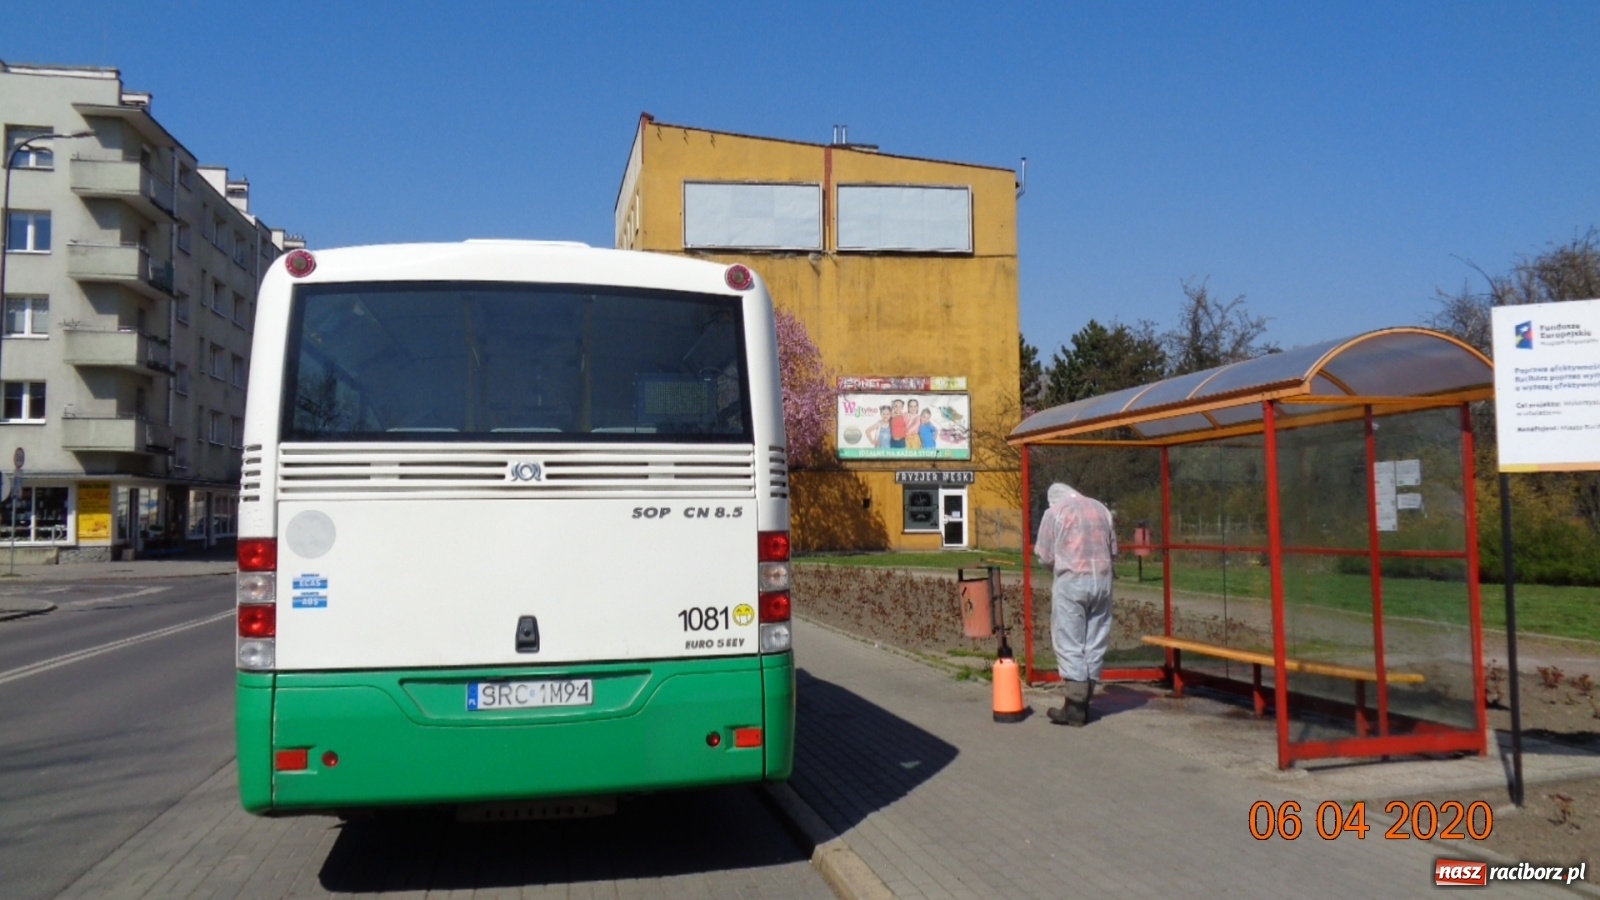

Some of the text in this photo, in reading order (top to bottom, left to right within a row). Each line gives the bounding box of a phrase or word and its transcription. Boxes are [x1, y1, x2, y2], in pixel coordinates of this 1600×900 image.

[895, 471, 938, 482] FRYZJER
[683, 507, 710, 518] CN
[714, 506, 743, 518] 8.5
[677, 606, 730, 632] 1081
[685, 639, 714, 650] EURO
[482, 681, 589, 706] SRC 1M94
